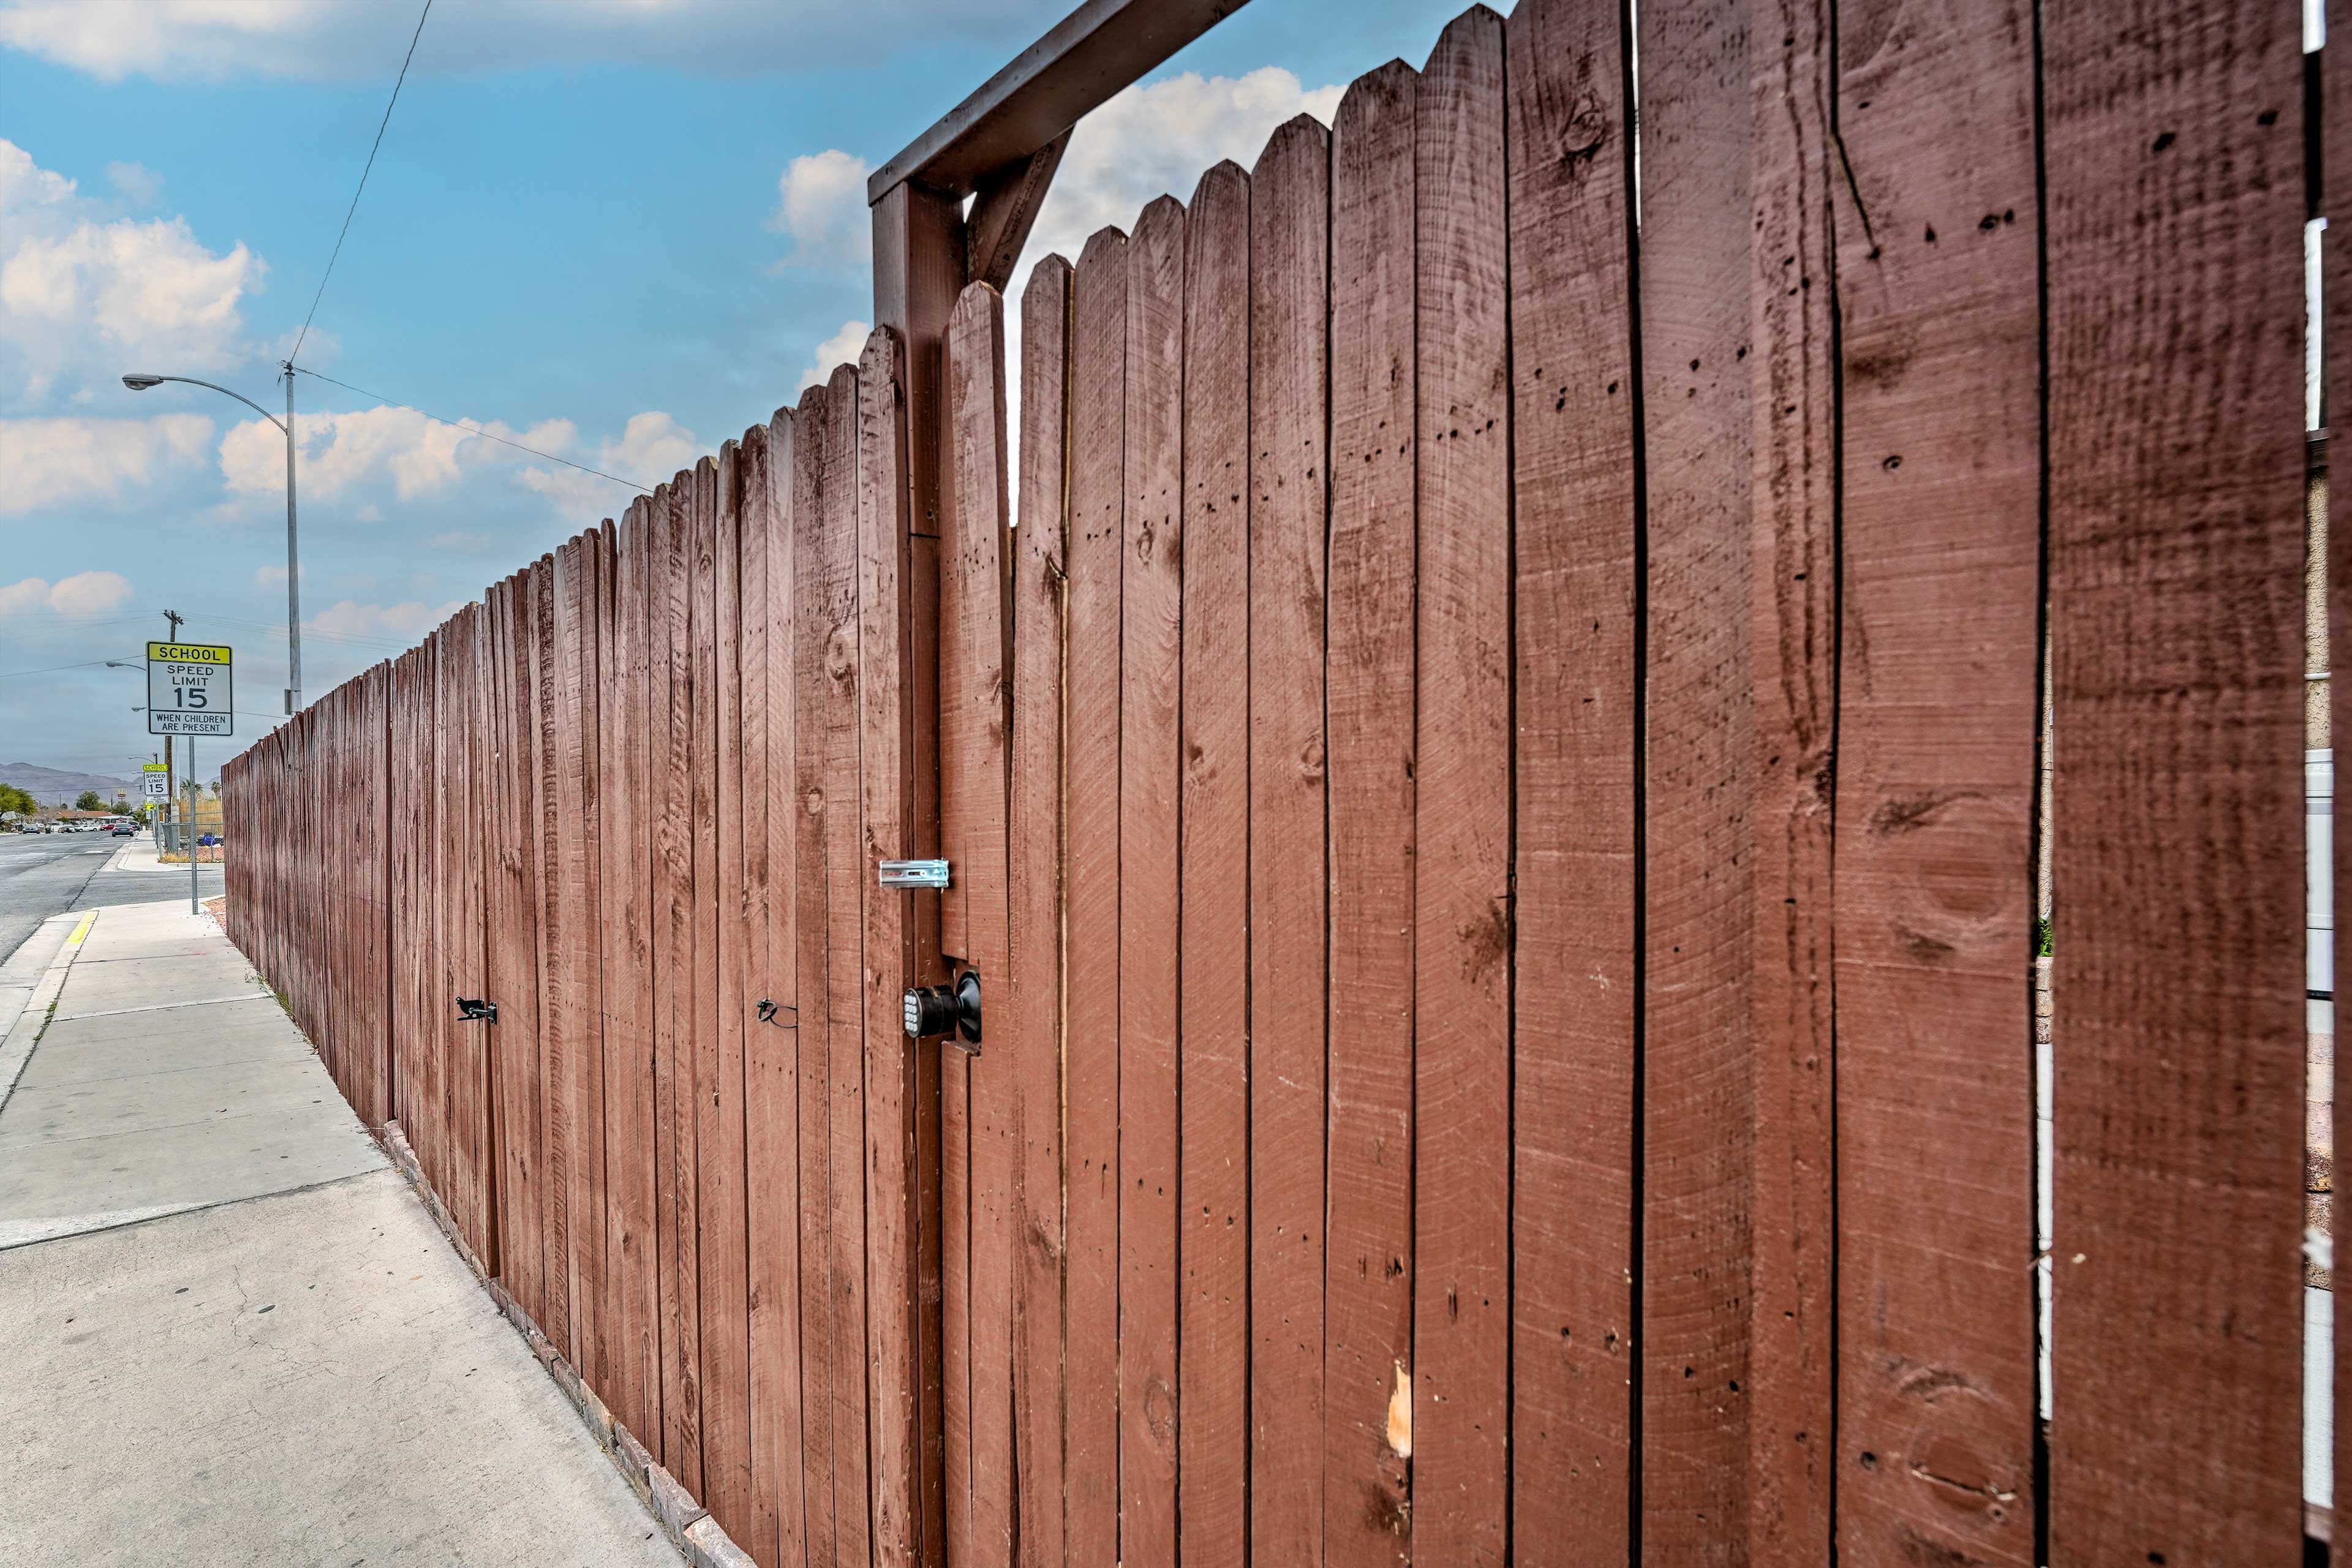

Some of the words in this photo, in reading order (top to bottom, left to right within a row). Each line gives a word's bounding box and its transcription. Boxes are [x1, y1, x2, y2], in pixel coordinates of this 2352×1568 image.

[159, 647, 221, 661] SCHOOL
[167, 665, 214, 676] SPEED
[172, 676, 209, 687] LIMIT
[174, 687, 208, 709] 15
[184, 715, 225, 723] CHILDREN
[183, 723, 221, 732] PRESENT
[149, 783, 164, 793] 15
